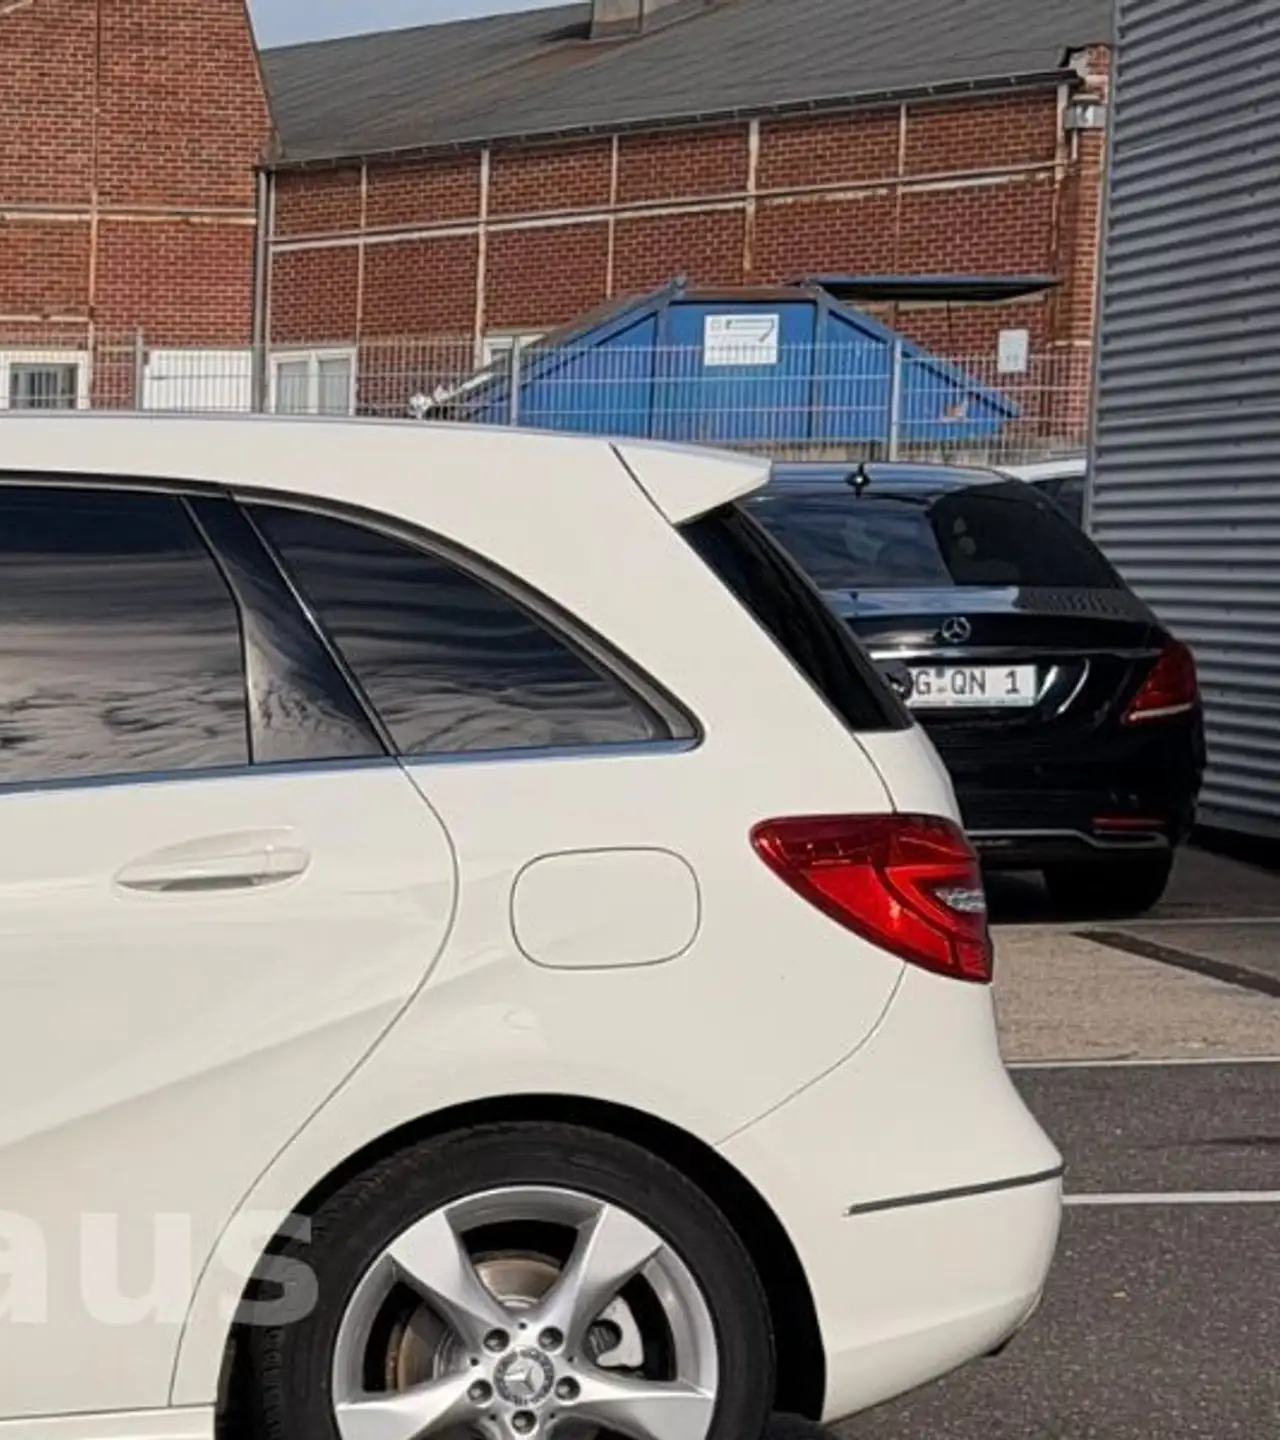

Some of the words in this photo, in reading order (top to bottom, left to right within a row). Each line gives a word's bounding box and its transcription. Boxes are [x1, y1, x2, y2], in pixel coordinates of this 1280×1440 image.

[915, 670, 932, 695] G
[951, 670, 987, 695] QN
[1004, 670, 1021, 695] 1
